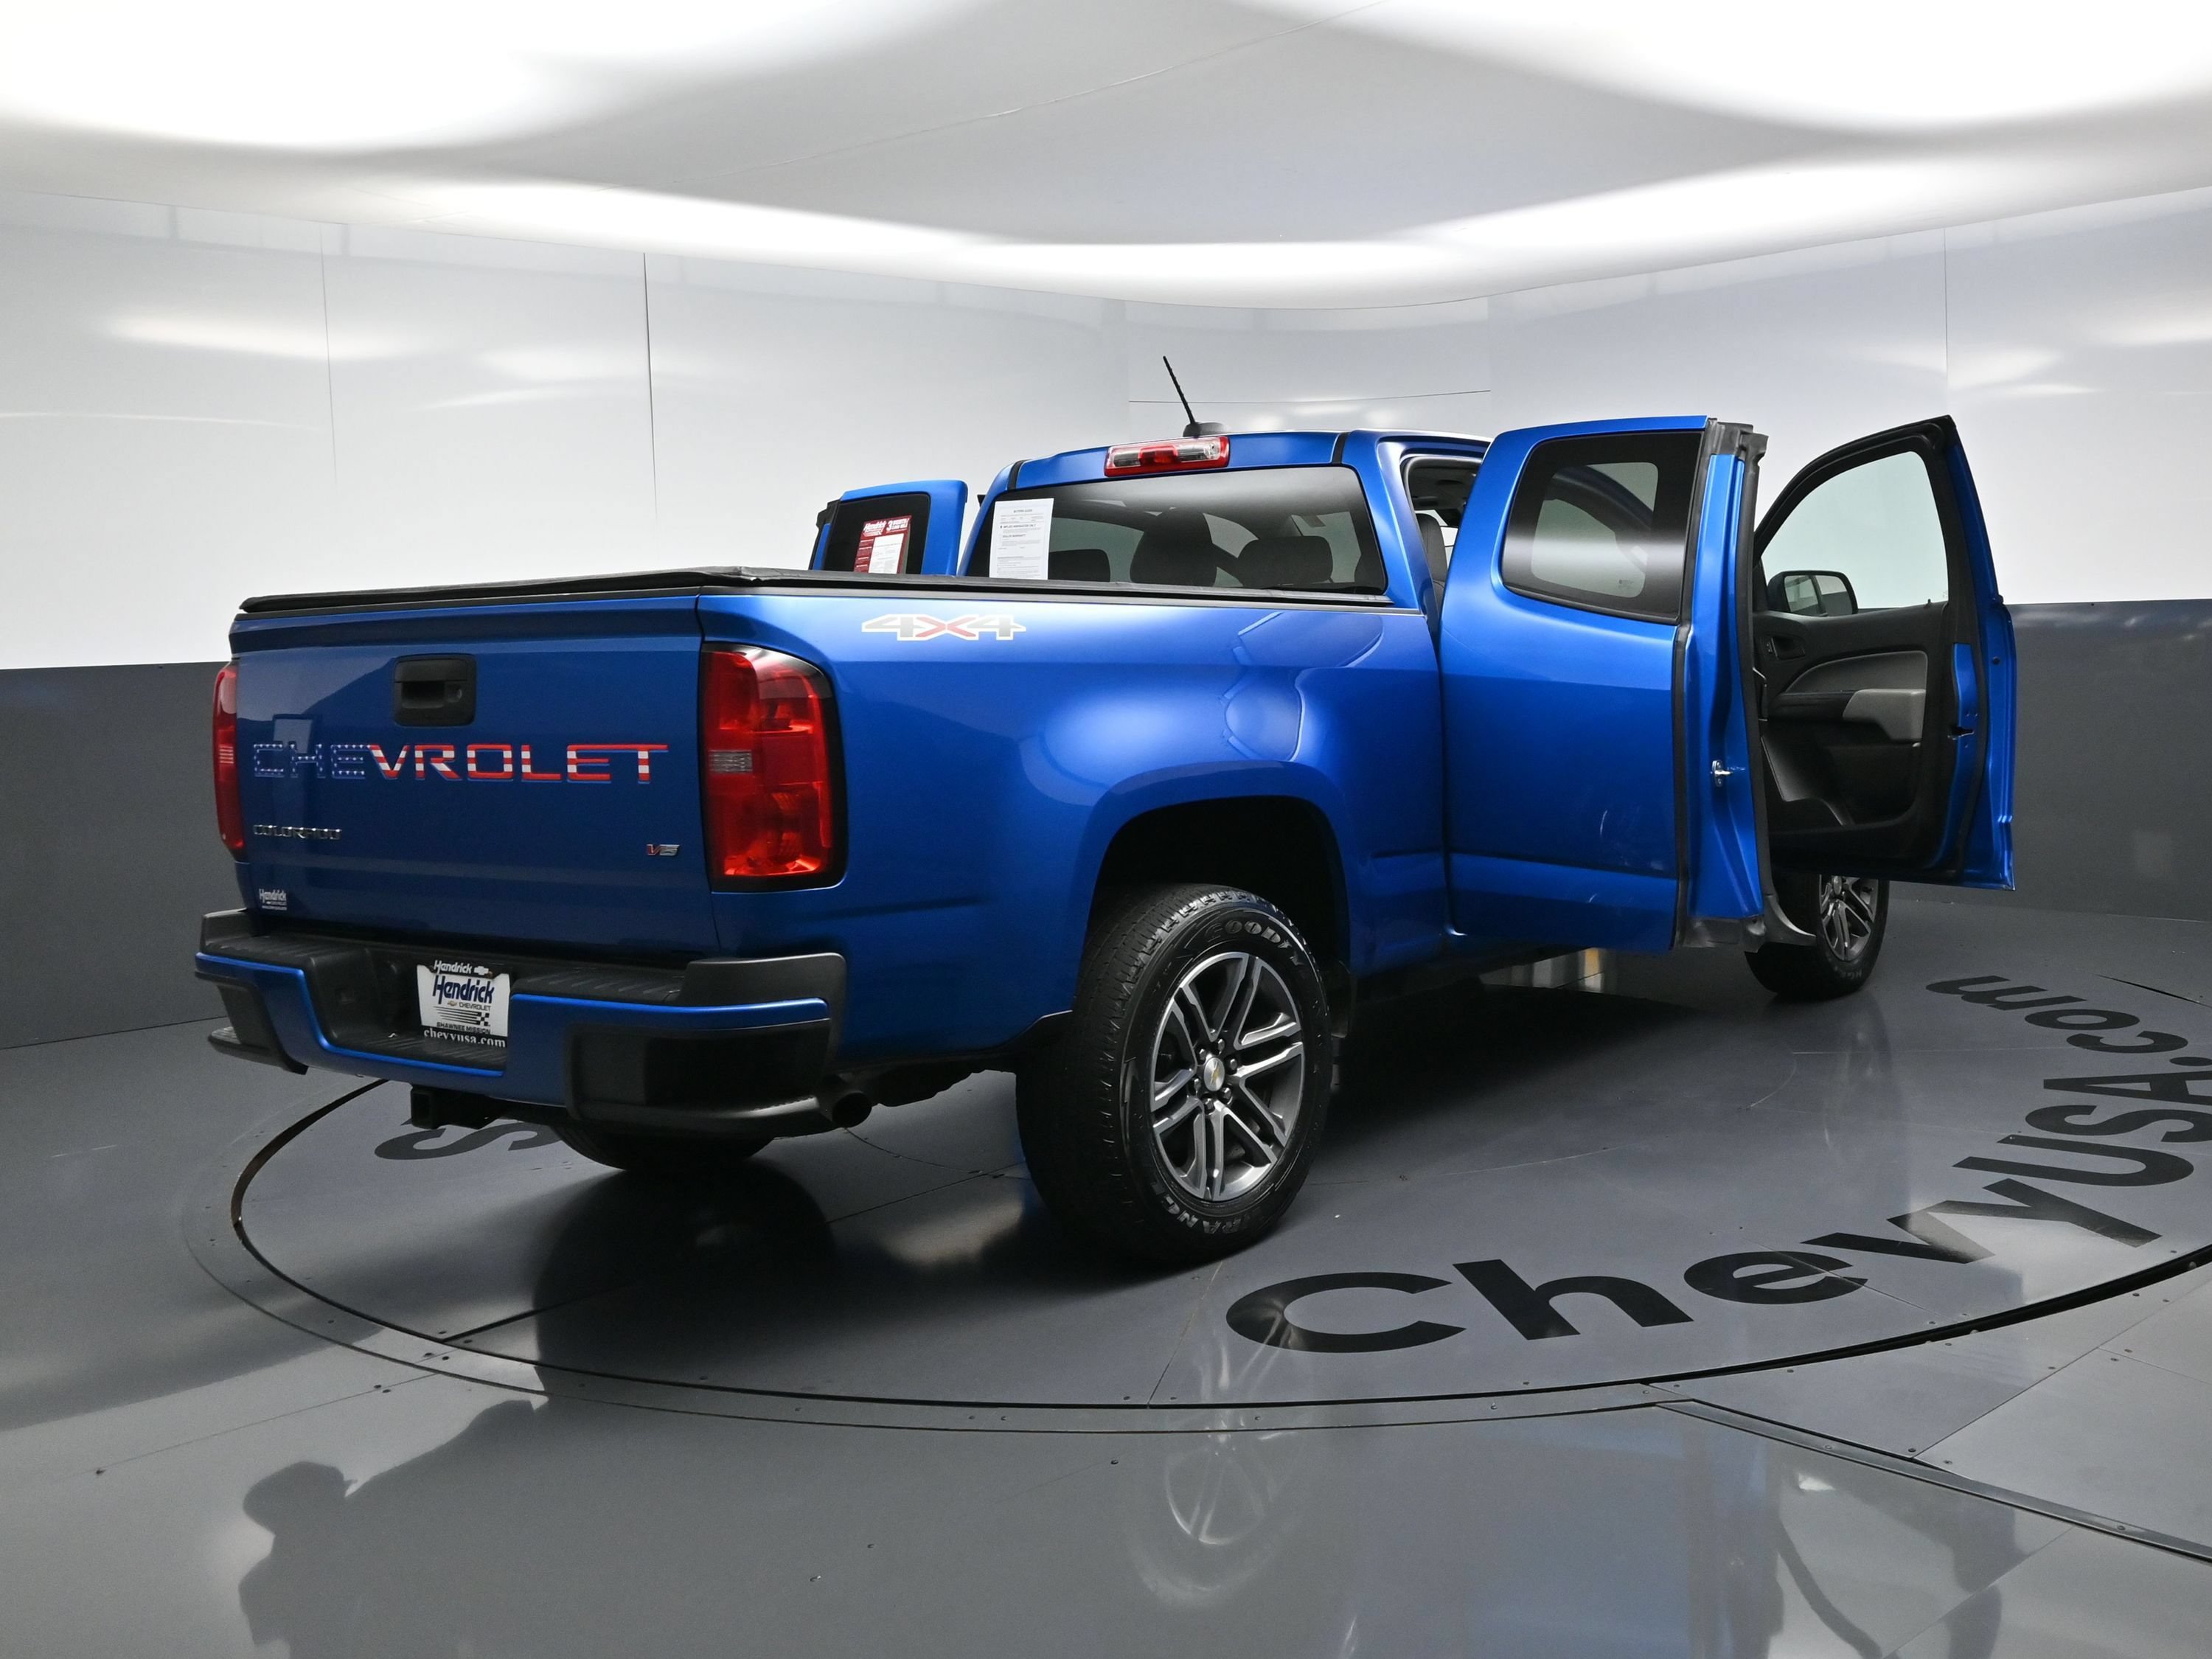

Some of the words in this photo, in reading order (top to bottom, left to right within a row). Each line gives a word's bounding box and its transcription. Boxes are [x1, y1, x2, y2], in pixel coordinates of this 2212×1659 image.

[253, 743, 669, 784] CHEVROLET
[253, 824, 342, 841] COLORADO
[646, 844, 681, 856] V6
[434, 959, 473, 975] Hendrick
[432, 974, 495, 1004] Hendrick
[459, 1001, 491, 1011] CHEVROLET
[437, 1021, 465, 1032] SHAWNEE
[465, 1025, 491, 1035] MISSION
[423, 1028, 506, 1048] chevyusa.com
[1225, 975, 2212, 1354] ChevyUSA.com
